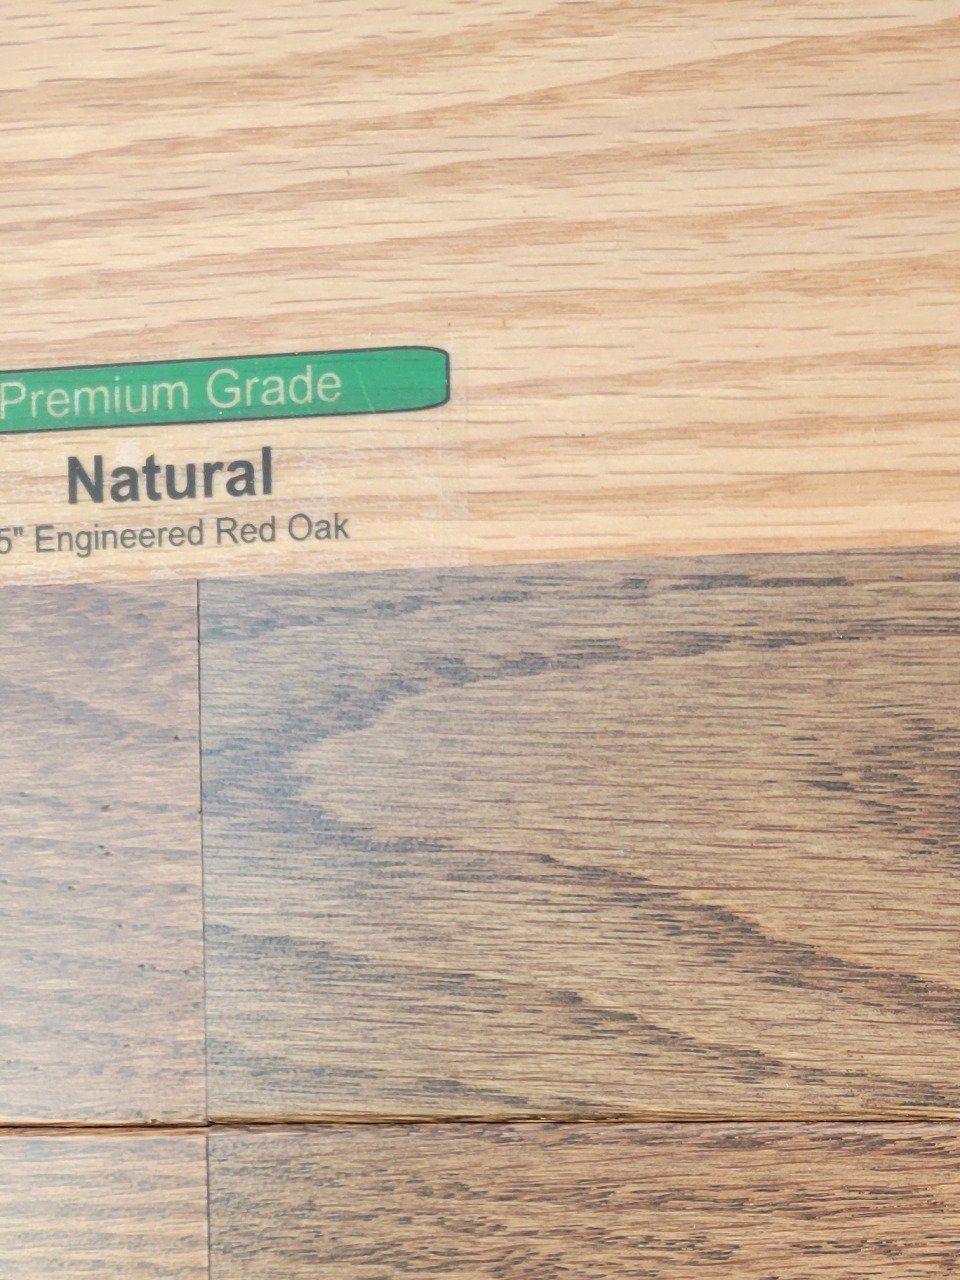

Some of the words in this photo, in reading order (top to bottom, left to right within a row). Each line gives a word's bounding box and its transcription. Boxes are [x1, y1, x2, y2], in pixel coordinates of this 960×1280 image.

[0, 376, 189, 419] Premium
[207, 365, 342, 409] Grade
[67, 447, 272, 504] Natural
[35, 518, 204, 558] Engineered
[217, 515, 276, 545] Red
[288, 512, 350, 540] Oak
